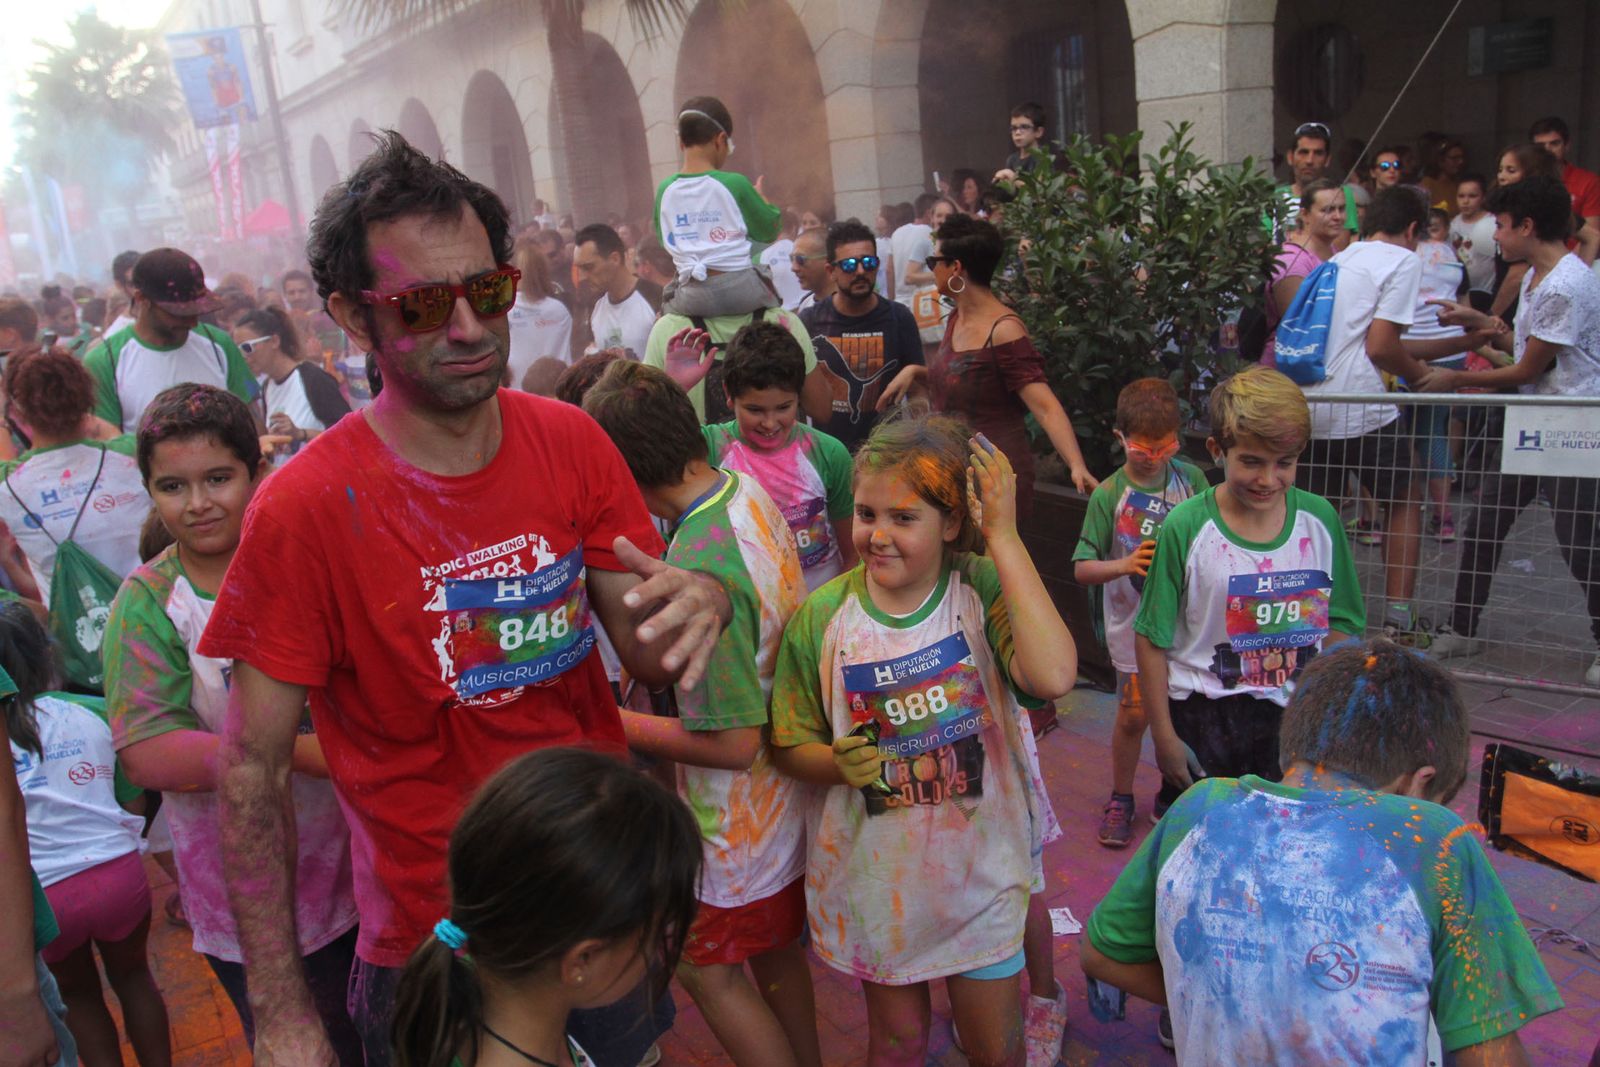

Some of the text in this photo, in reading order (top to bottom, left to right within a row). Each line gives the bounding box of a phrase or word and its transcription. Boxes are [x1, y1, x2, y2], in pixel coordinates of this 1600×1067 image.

[1544, 440, 1559, 449] DE
[468, 537, 525, 563] WALKING
[525, 572, 569, 596] DE HUELVA
[526, 559, 571, 586] DIPUTACIÓN
[1257, 576, 1272, 590] H
[497, 580, 521, 598] H
[1273, 580, 1305, 590] DE HUELVA
[1256, 600, 1300, 625] 979
[499, 605, 569, 650] 848
[1232, 636, 1286, 648] MusicRun
[460, 634, 594, 689] MusicRun Colors
[893, 647, 942, 671] DIPUTACIÓN
[896, 659, 942, 680] DE HUELVA
[874, 666, 894, 683] H
[884, 685, 949, 726] 988
[943, 713, 986, 739] Colors
